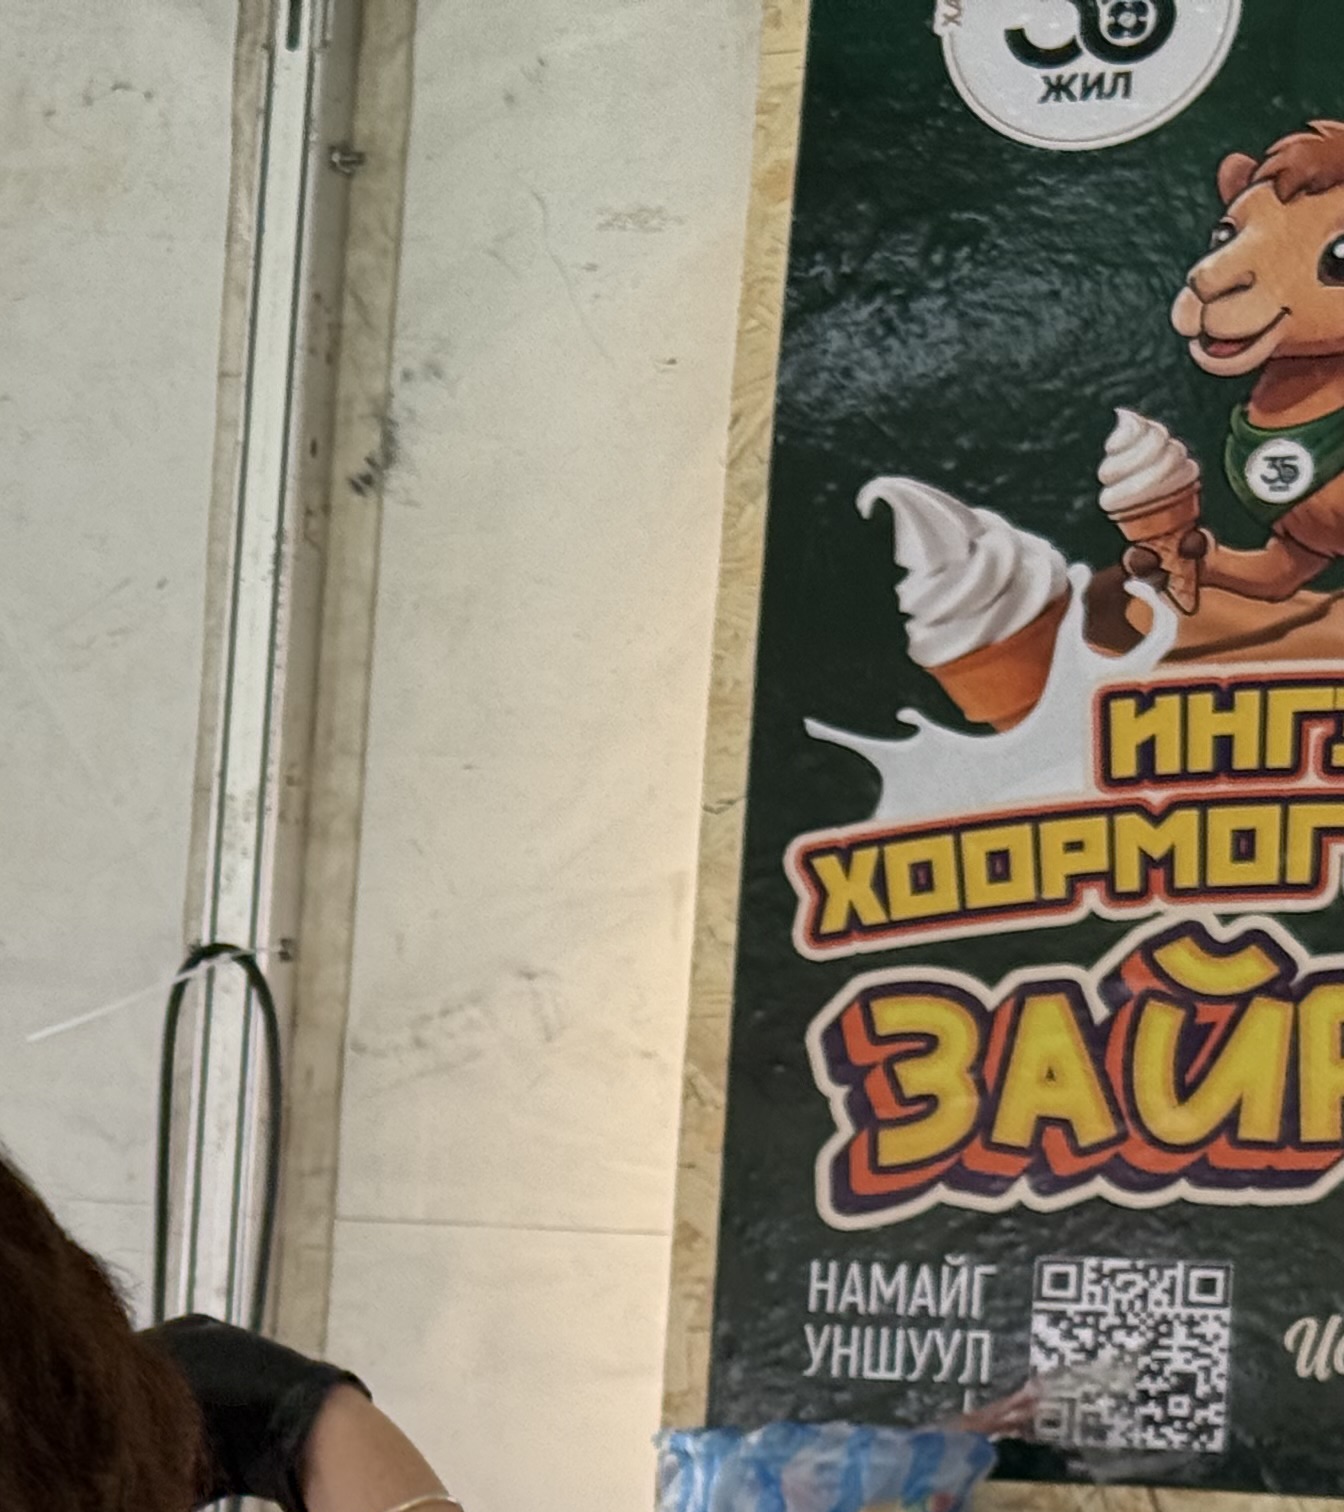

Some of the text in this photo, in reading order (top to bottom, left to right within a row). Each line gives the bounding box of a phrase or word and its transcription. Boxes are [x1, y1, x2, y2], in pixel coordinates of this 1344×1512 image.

[1037, 71, 1133, 103] ЖИЛ
[1111, 686, 1344, 779] ИНГ
[807, 1254, 997, 1320] НАМАЙГ
[802, 1324, 992, 1384] УНШУУЛ
